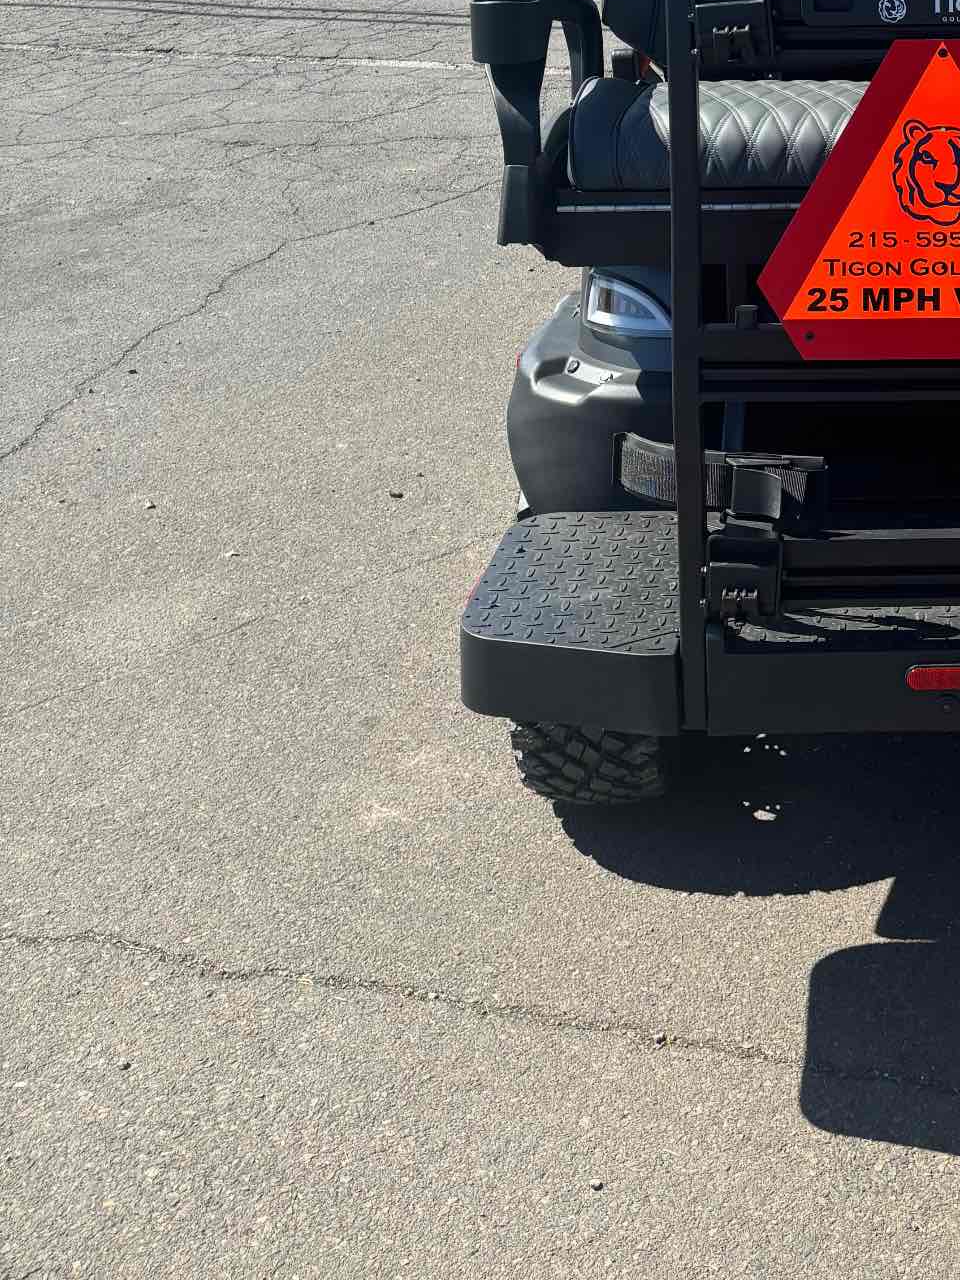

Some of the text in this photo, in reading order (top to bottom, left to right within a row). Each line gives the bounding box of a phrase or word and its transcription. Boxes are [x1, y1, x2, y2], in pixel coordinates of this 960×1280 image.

[823, 258, 901, 277] TIGON
[806, 287, 849, 312] 25
[862, 287, 941, 312] MPH
